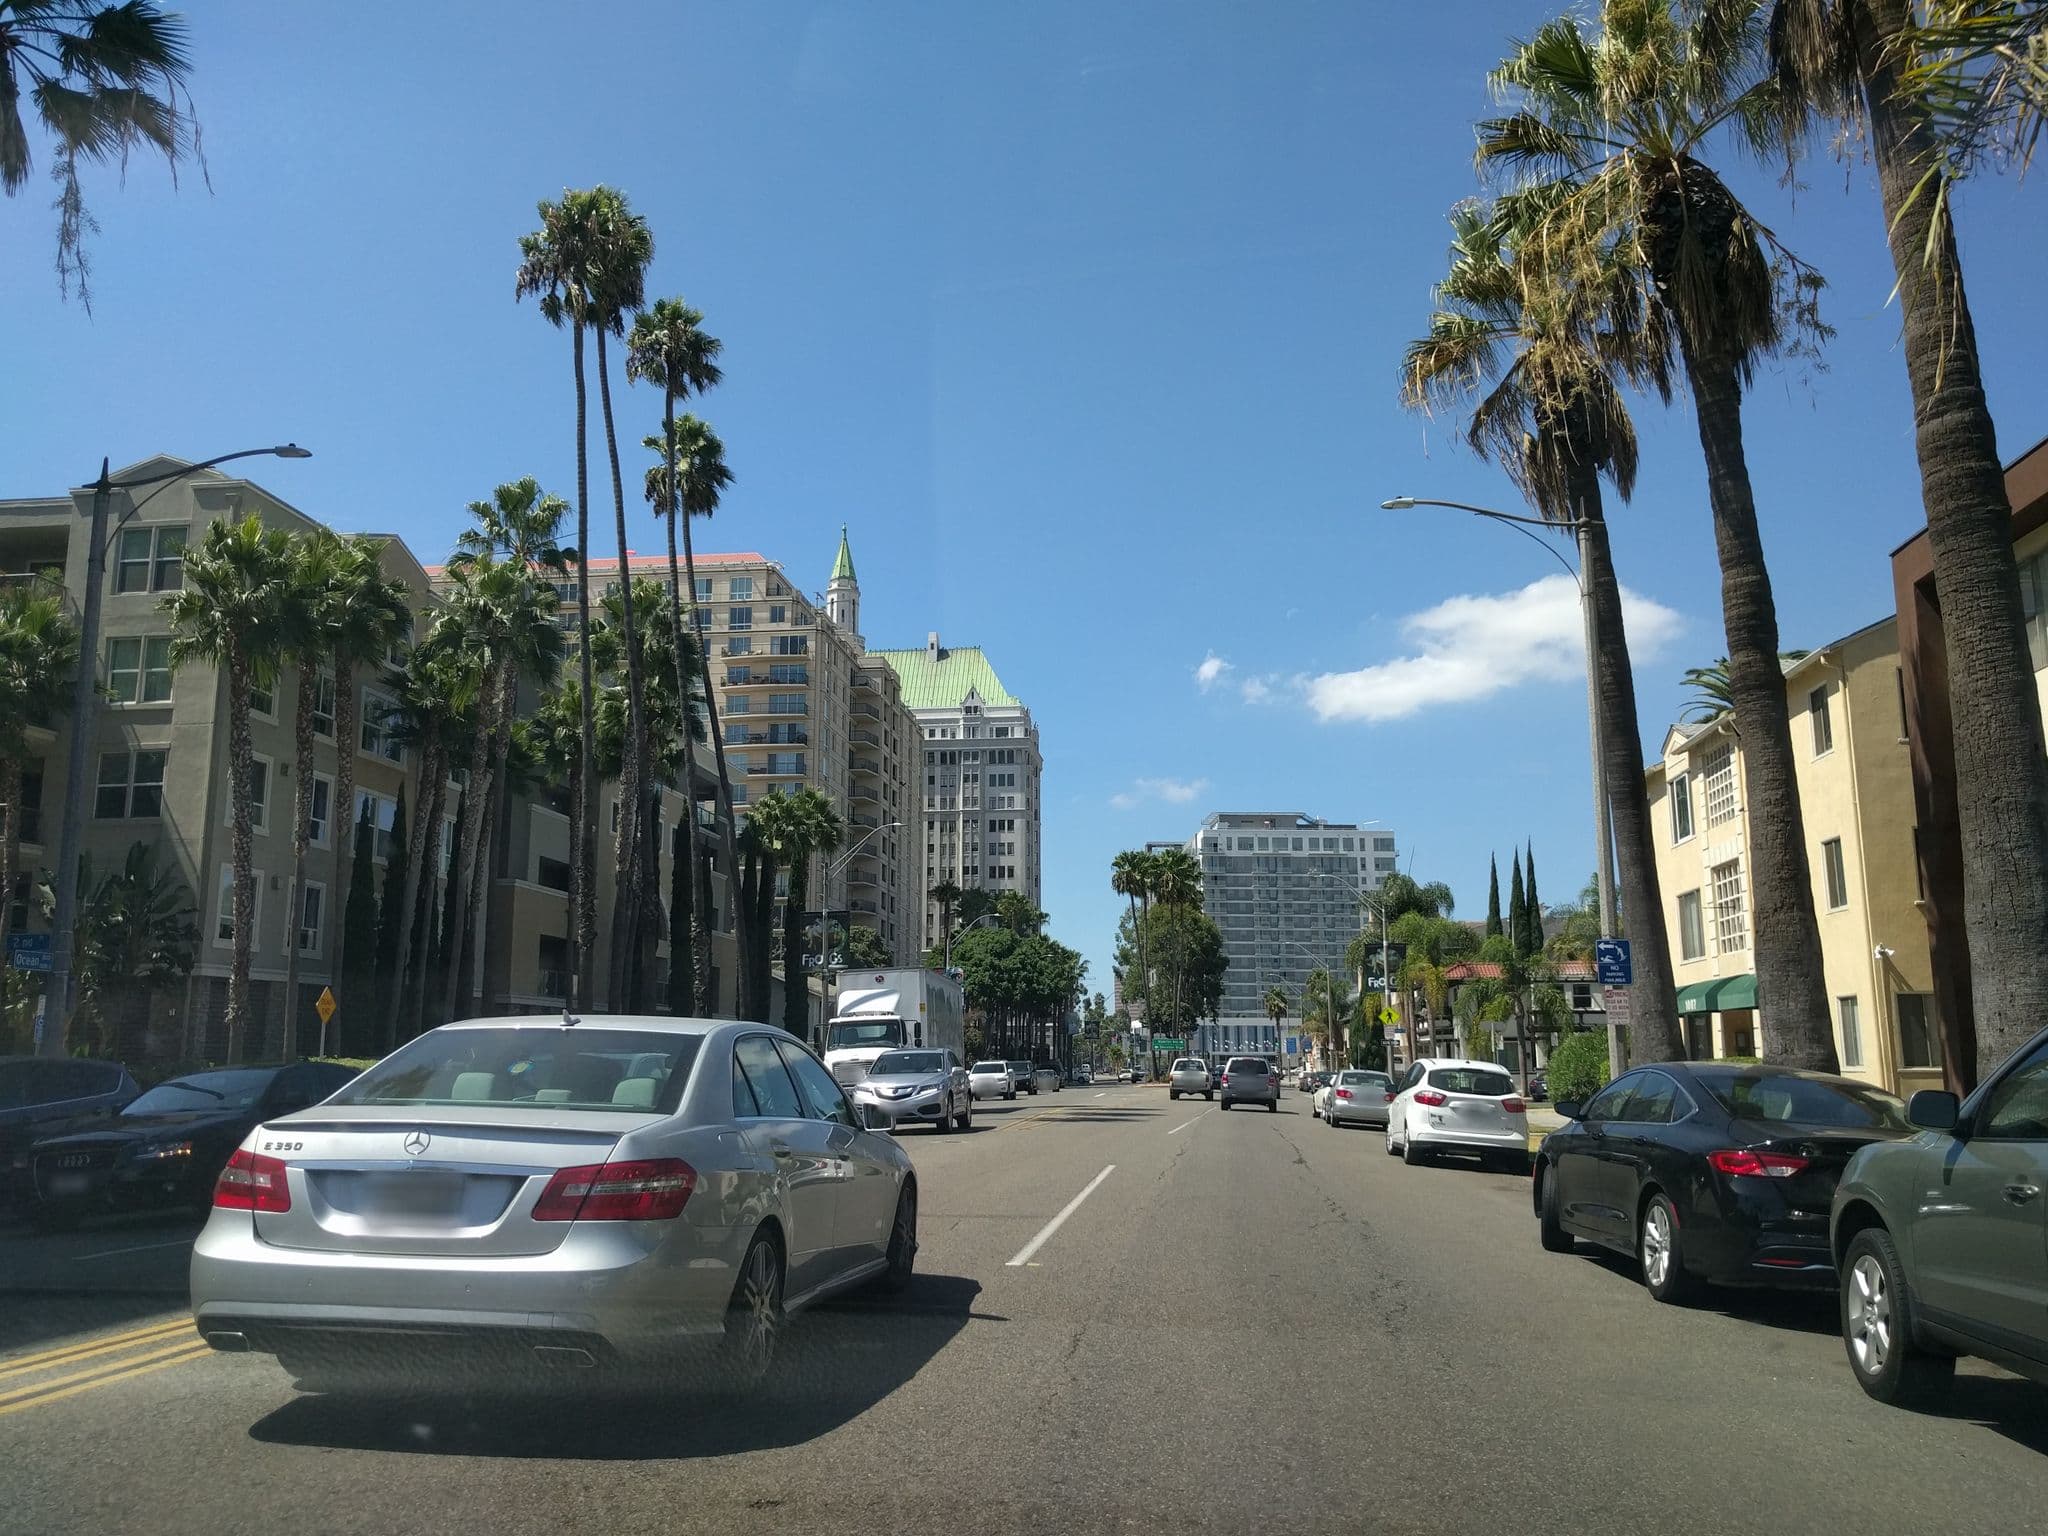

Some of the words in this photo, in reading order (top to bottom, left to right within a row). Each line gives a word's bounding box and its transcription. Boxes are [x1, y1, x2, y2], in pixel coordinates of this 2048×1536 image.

[16, 953, 40, 967] Ocean
[263, 1141, 274, 1151] E
[274, 1141, 304, 1151] 350
